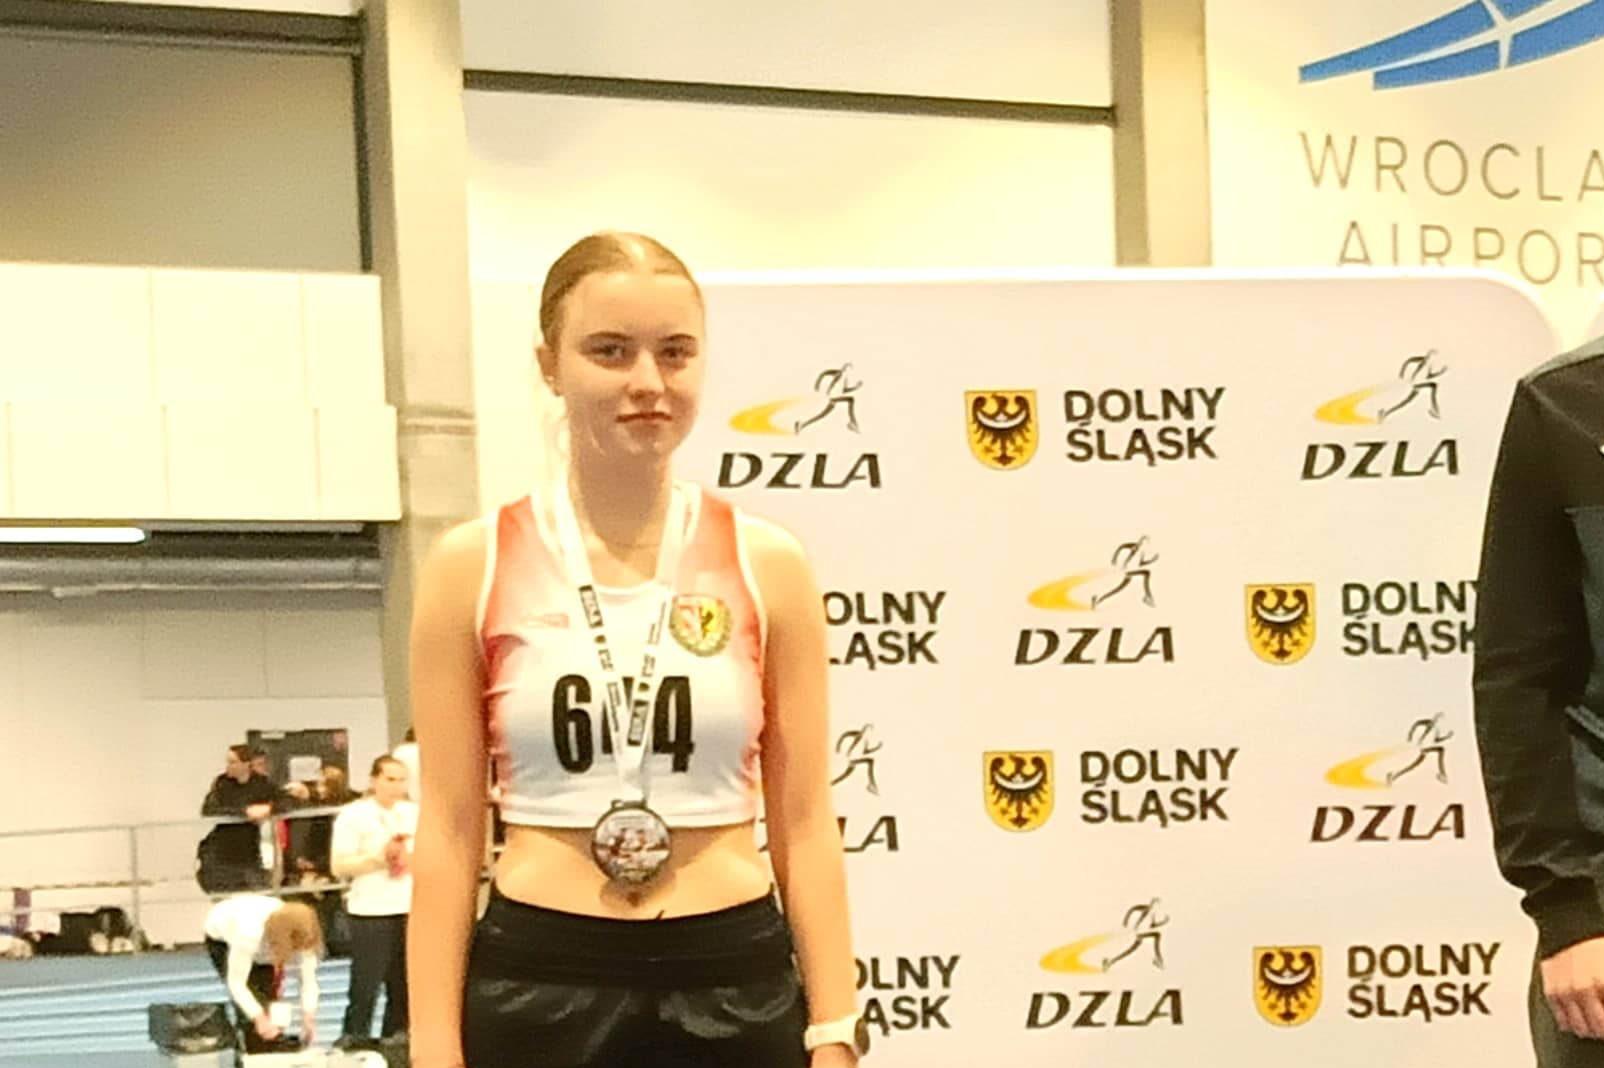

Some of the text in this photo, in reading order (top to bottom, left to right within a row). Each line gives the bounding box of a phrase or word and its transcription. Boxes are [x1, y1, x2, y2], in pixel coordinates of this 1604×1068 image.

[1064, 388, 1224, 423] DOLNY
[1067, 420, 1216, 466] ŚLĄSK
[1302, 439, 1458, 479] DZLA
[718, 453, 880, 488] DZLA
[823, 592, 945, 625] OLNY
[829, 630, 936, 670] ĄSK
[1015, 627, 1173, 664] DZLA
[1081, 748, 1238, 783] DOLNY
[1082, 781, 1227, 827] ŚLĄSK
[1311, 804, 1464, 842] DZLA
[855, 956, 959, 990] LNY
[1348, 943, 1500, 978] DOLNY
[863, 996, 949, 1037] ĄSK
[1027, 990, 1182, 1028] DZLA
[1348, 976, 1490, 1022] ŚLĄSK
